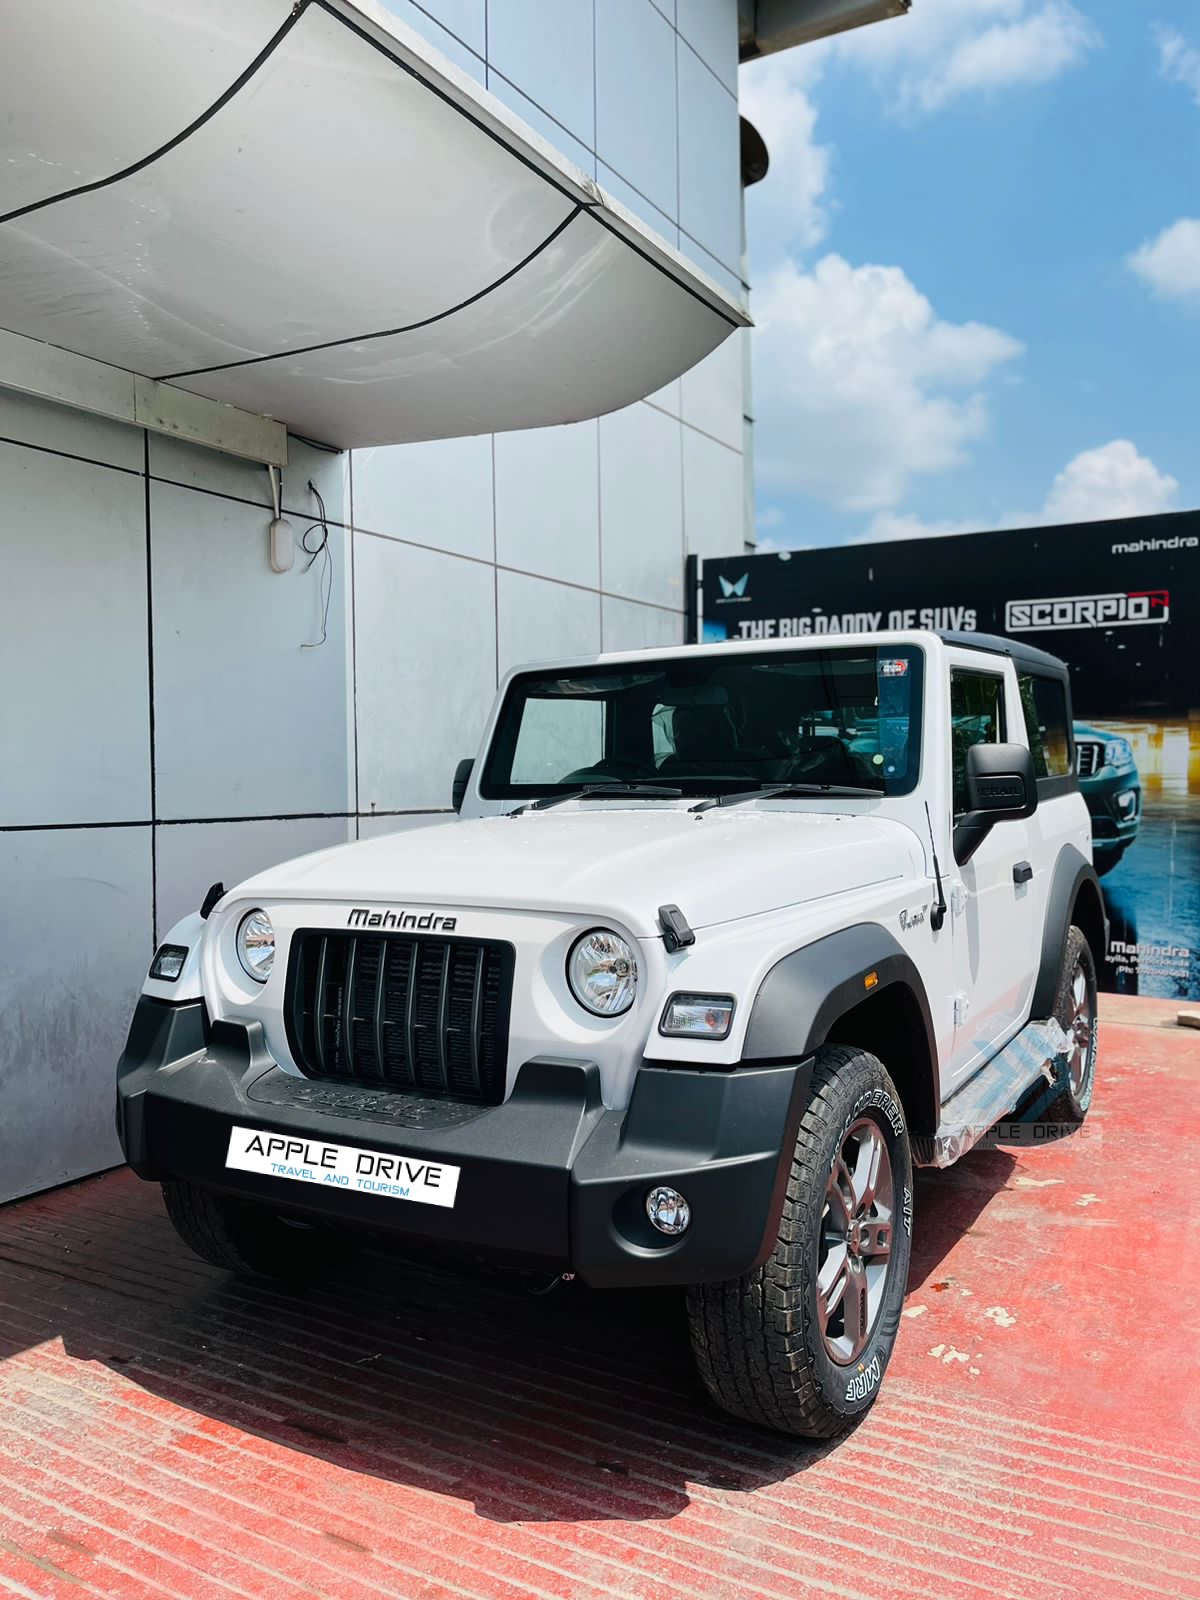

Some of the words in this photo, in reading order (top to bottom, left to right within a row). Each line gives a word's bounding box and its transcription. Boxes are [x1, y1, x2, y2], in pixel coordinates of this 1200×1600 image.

[1112, 536, 1199, 554] mahindra
[738, 619, 776, 639] THE
[779, 616, 811, 637] BIG
[889, 609, 916, 631] OF
[920, 606, 977, 632] SUVs
[1011, 597, 1149, 628] SCORPIO
[347, 908, 457, 930] Mahindra
[845, 1356, 880, 1401] MRF
